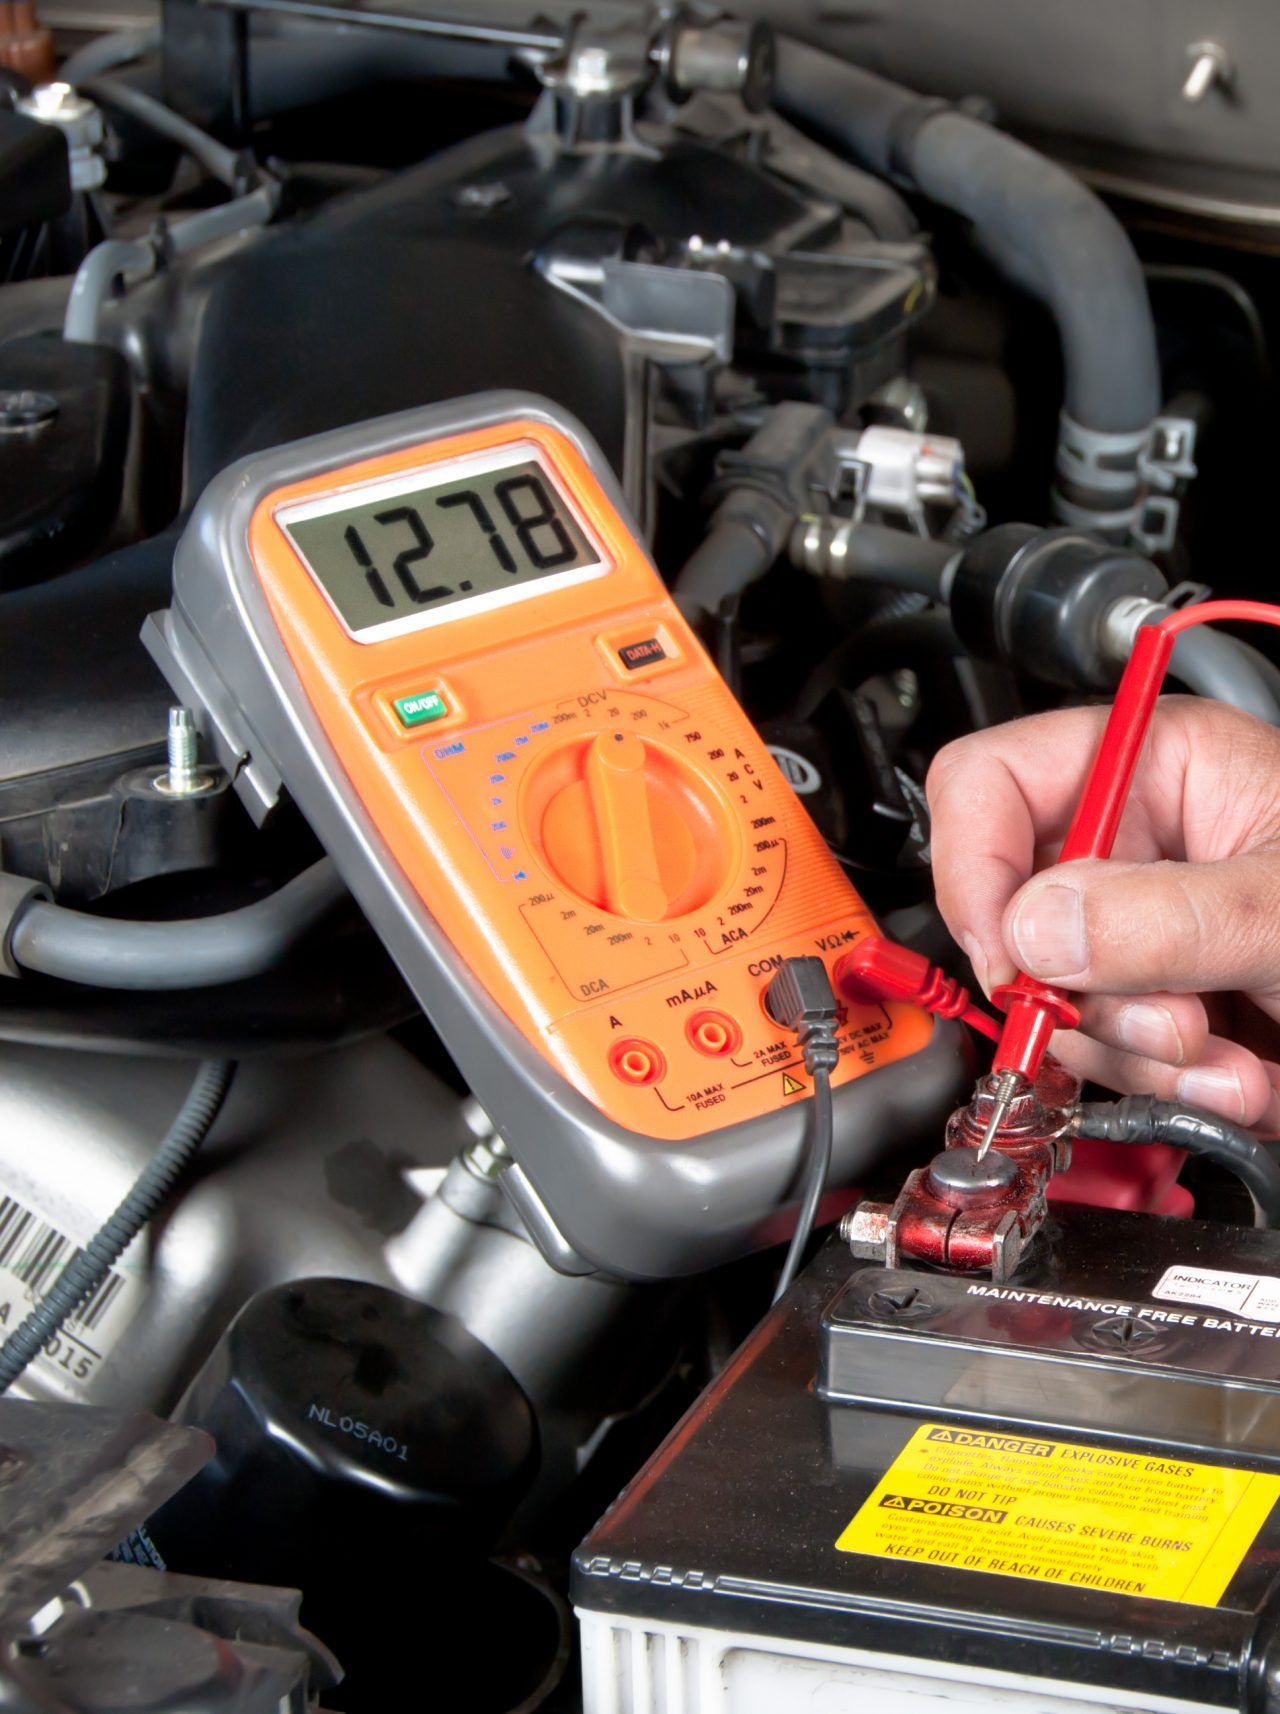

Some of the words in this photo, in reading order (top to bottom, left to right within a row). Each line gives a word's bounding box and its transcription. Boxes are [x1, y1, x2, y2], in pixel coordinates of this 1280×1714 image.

[344, 473, 578, 609] 12.78
[626, 643, 661, 660] DATA-H
[402, 693, 441, 716] ON/OFF
[576, 689, 607, 708] DCV
[684, 731, 702, 743] 750
[707, 748, 726, 760] 200
[727, 771, 740, 782] 20
[739, 794, 749, 804] 2
[750, 816, 777, 829] 200m
[751, 866, 768, 877] 2m
[743, 885, 764, 897] 20m
[727, 902, 754, 916] 200m
[560, 910, 577, 920] 2m
[607, 931, 634, 946] 200m
[716, 916, 726, 926] 2
[693, 927, 706, 938] 10
[721, 927, 749, 945] ACA
[581, 978, 610, 997] DCA
[609, 1015, 623, 1030] A
[747, 954, 784, 978] COM
[753, 1050, 766, 1060] 2A
[767, 1040, 788, 1054] MAX
[761, 1050, 793, 1068] FUSED
[686, 1091, 704, 1103] 10A
[703, 1082, 725, 1096] MAX
[695, 1093, 727, 1111] FUSED
[1173, 1273, 1253, 1292] INDICATOR
[966, 1284, 1134, 1318] MAINTENANCE
[1137, 1308, 1199, 1327] FREE
[954, 1433, 1052, 1458] DANGER
[1060, 1447, 1143, 1470] EXPLOSIVE
[1144, 1460, 1197, 1479] GASES
[927, 1484, 951, 1499] DO
[954, 1488, 987, 1503] NOT
[991, 1493, 1019, 1507] TIP
[987, 1481, 1032, 1494] without
[906, 1498, 1004, 1524] POISON
[1014, 1514, 1076, 1533] CAUSES
[1079, 1525, 1138, 1545] SEVERE
[1140, 1535, 1193, 1552] BURNS
[884, 1543, 925, 1558] KEEP
[927, 1549, 962, 1564] OUT
[963, 1555, 989, 1569] OF
[988, 1558, 1041, 1577] REACH
[1044, 1566, 1069, 1581] OF
[1069, 1571, 1147, 1594] CHILDREN
